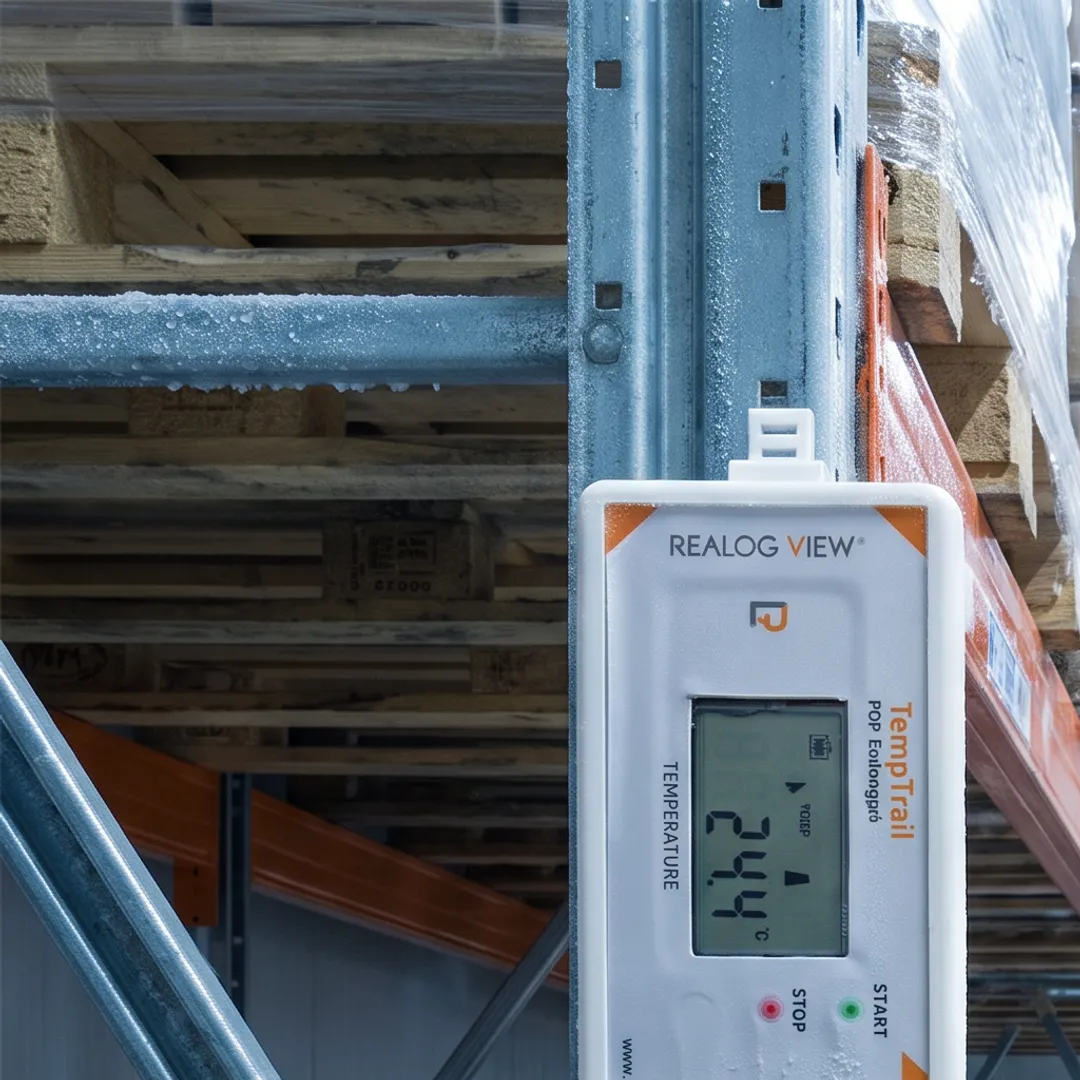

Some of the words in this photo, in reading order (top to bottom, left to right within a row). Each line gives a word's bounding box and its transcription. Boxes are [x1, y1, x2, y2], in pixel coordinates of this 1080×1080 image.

[669, 534, 779, 558] REALOG
[867, 700, 881, 732] POP
[884, 702, 915, 839] TempTrail
[662, 761, 679, 890] TEMPERATURE
[706, 810, 770, 919] 24.4
[791, 988, 806, 1032] STOP
[873, 983, 888, 1038] START
